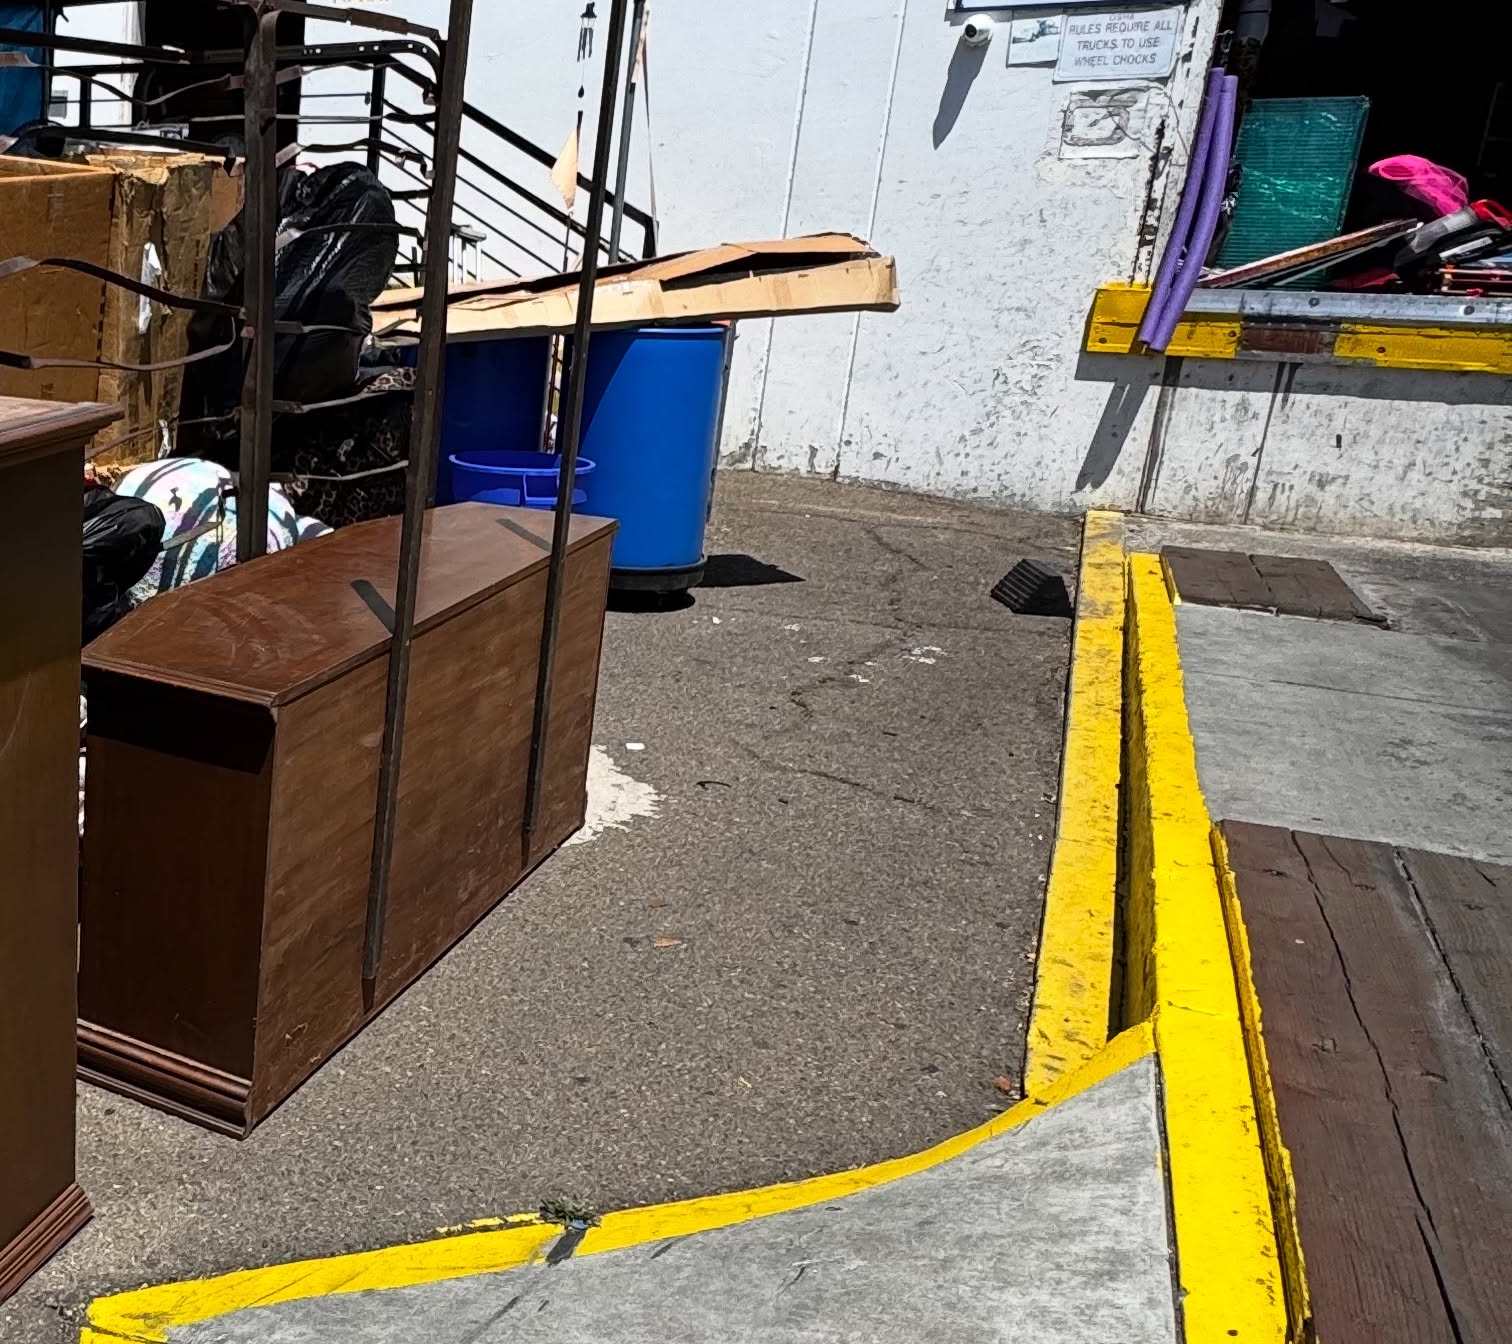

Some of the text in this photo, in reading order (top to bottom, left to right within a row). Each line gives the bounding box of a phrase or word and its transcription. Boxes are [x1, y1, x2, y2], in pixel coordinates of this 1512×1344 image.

[1069, 19, 1173, 35] RULES REQUIRE ALL
[1077, 36, 1161, 51] TRUCKS TO USE
[1074, 53, 1157, 67] WHEEL CHOCKS
